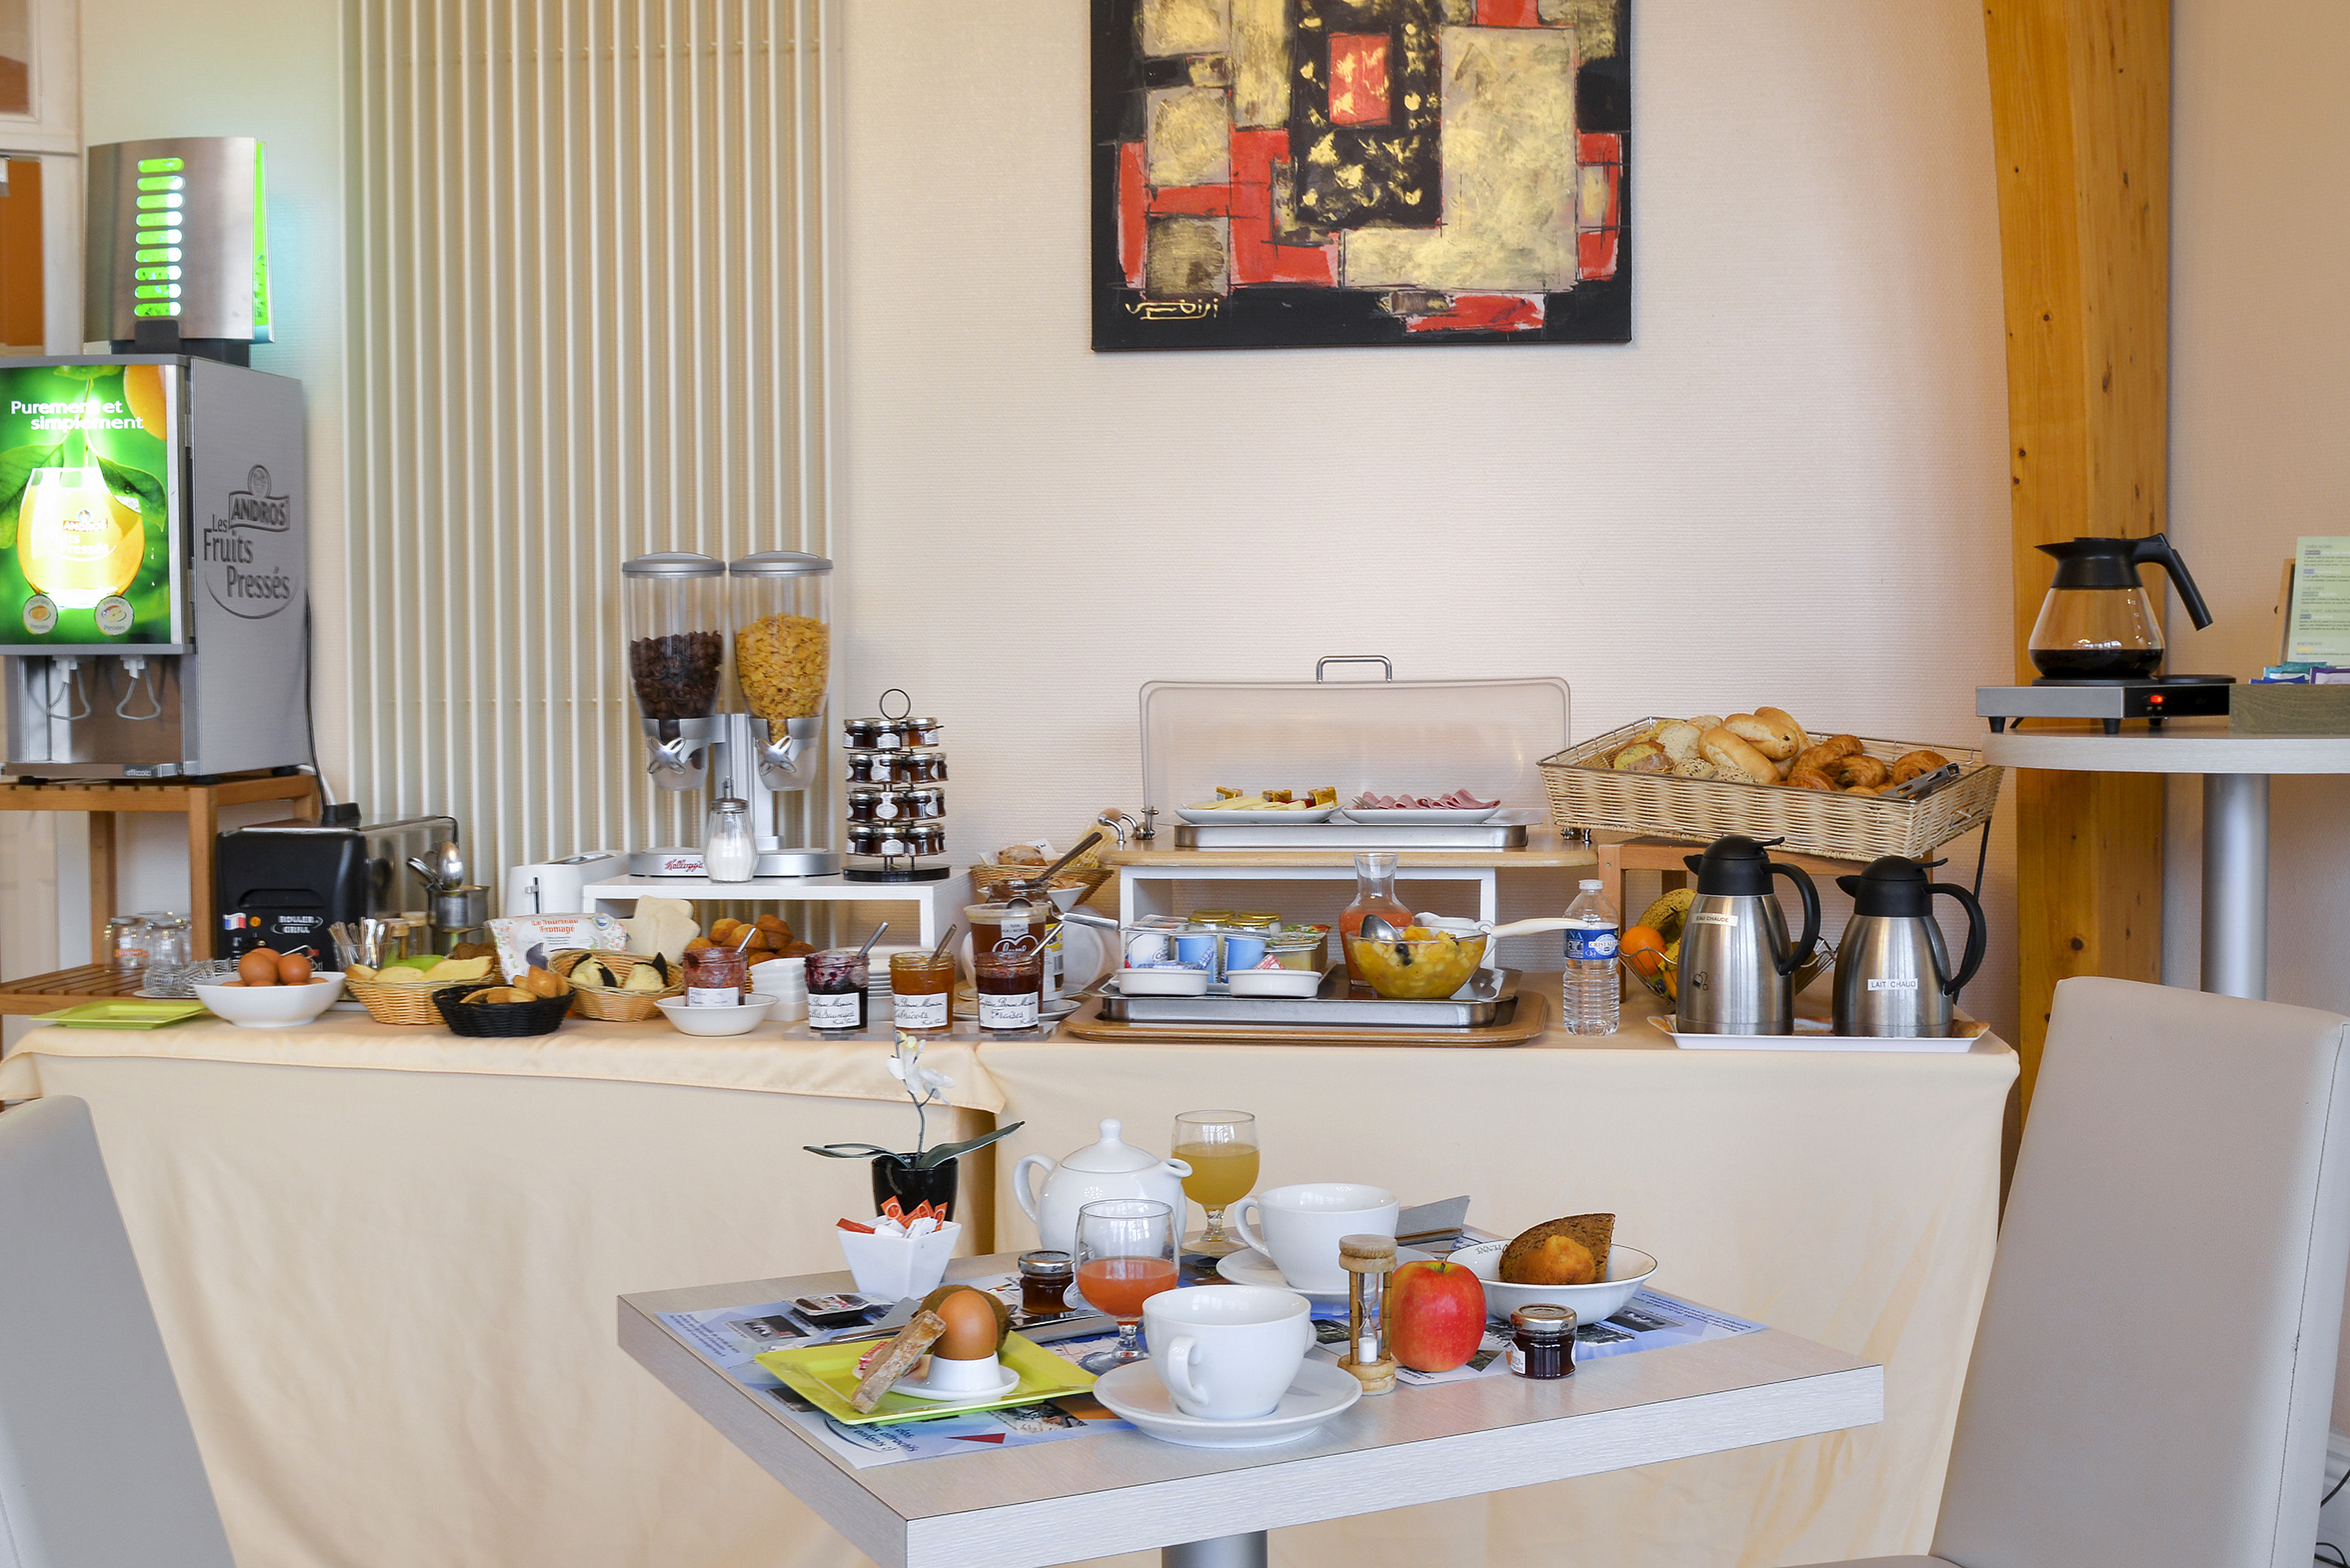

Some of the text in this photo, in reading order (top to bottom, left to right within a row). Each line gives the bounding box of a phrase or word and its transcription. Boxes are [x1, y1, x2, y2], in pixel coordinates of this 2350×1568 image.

[102, 400, 123, 414] et
[31, 415, 144, 433] simplement
[231, 498, 287, 526] ANDROS
[212, 514, 228, 532] Les
[203, 528, 254, 564] Fruits
[226, 565, 291, 600] Pressés
[664, 858, 705, 873] Kellogg's
